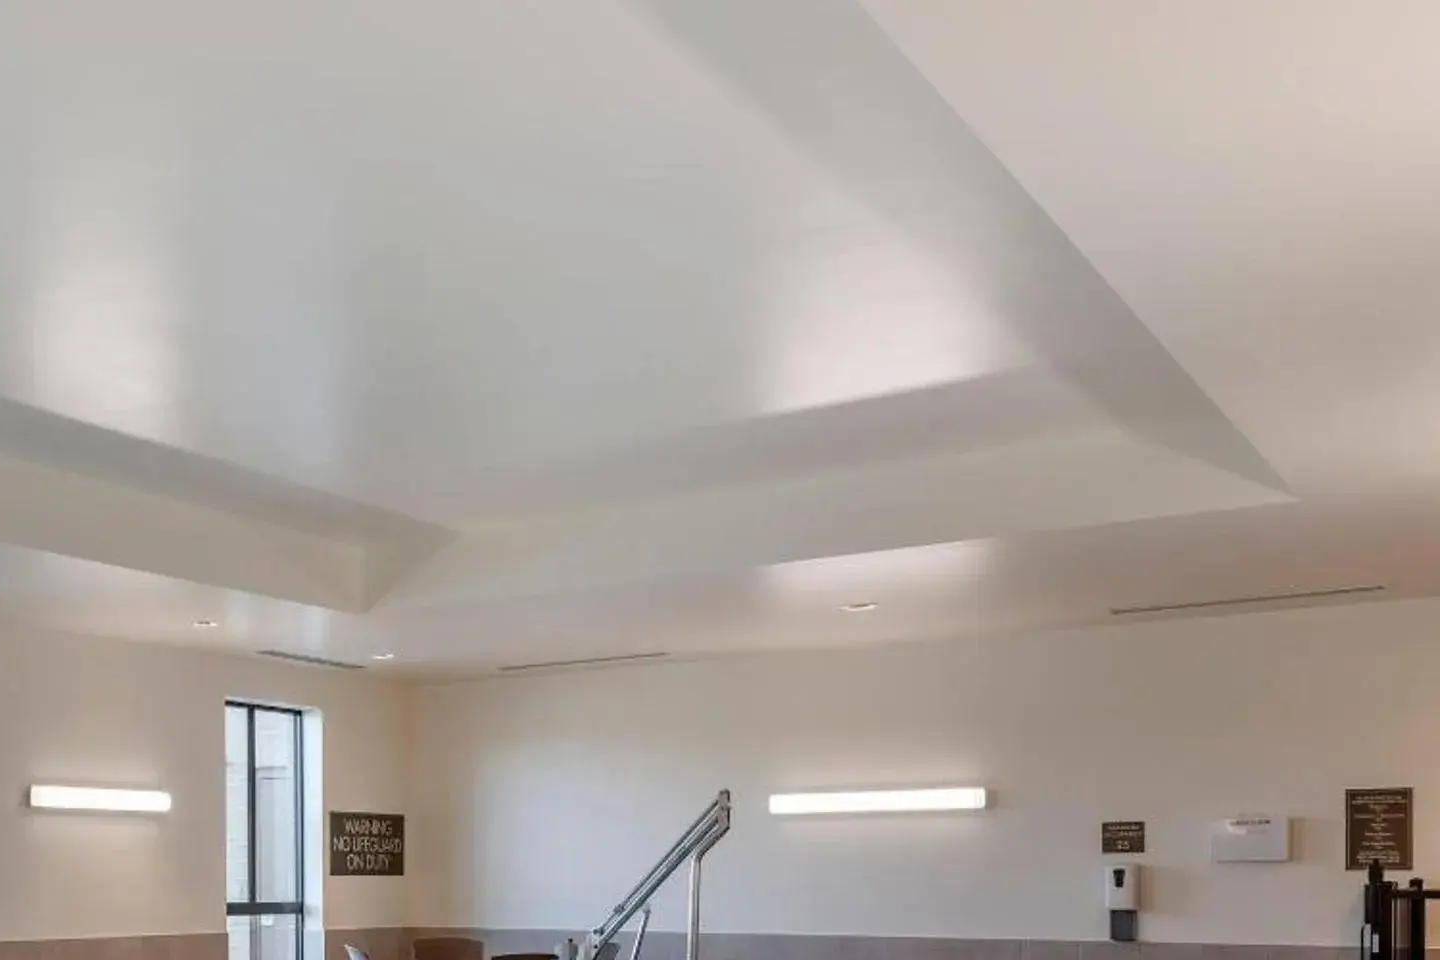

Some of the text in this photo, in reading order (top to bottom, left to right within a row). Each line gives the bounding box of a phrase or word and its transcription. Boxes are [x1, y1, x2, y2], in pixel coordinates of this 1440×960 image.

[344, 818, 393, 835] WARNING
[333, 836, 401, 853] NO LIFEGUARD
[346, 854, 389, 870] ON DUTY
